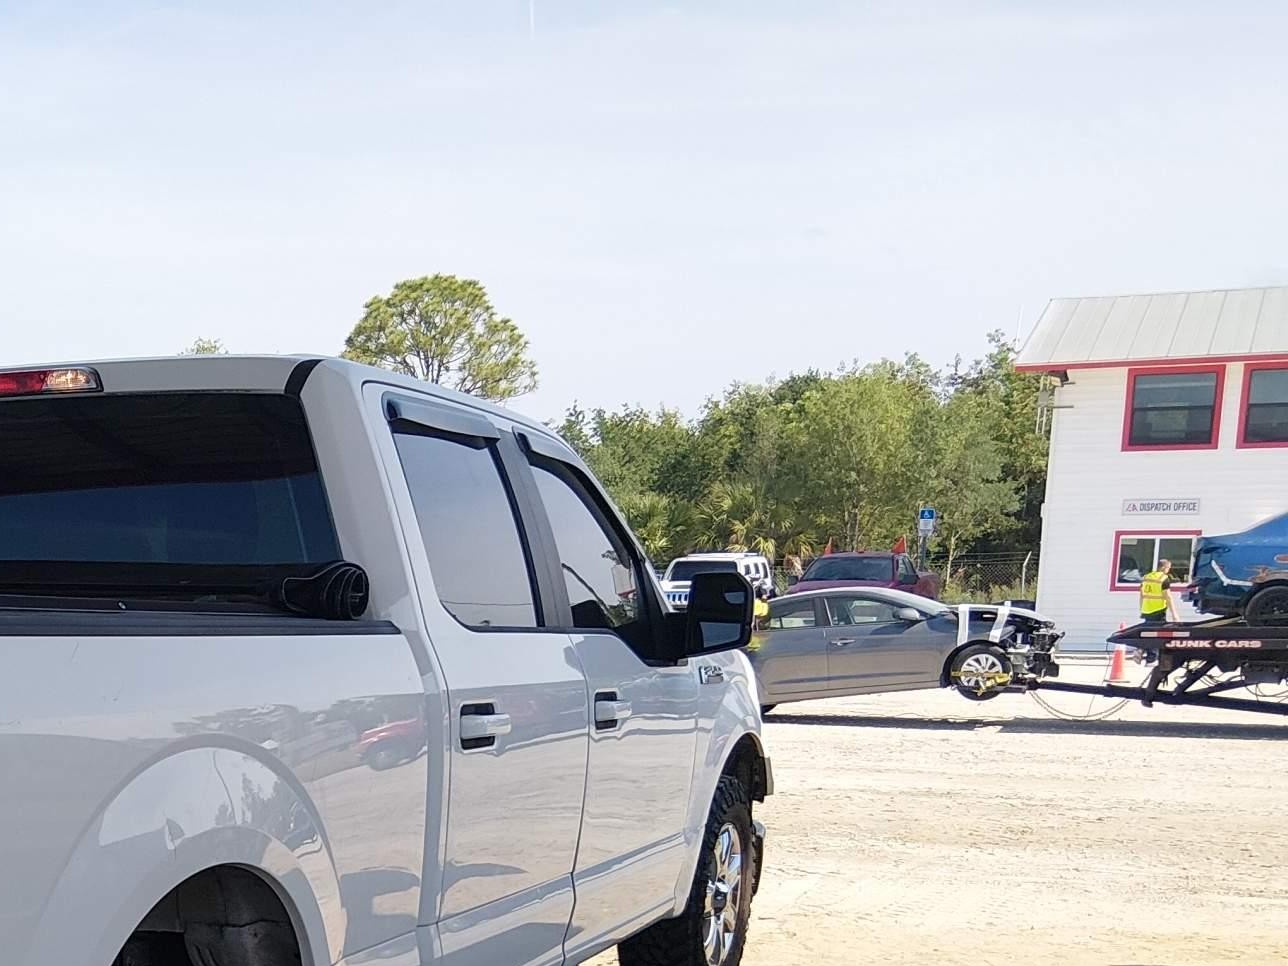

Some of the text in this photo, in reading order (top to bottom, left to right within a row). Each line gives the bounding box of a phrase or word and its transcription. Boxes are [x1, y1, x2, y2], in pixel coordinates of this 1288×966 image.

[1140, 502, 1171, 511] DISPATCH
[1173, 502, 1197, 511] OFFICE
[1165, 640, 1262, 648] JUNK CARS
